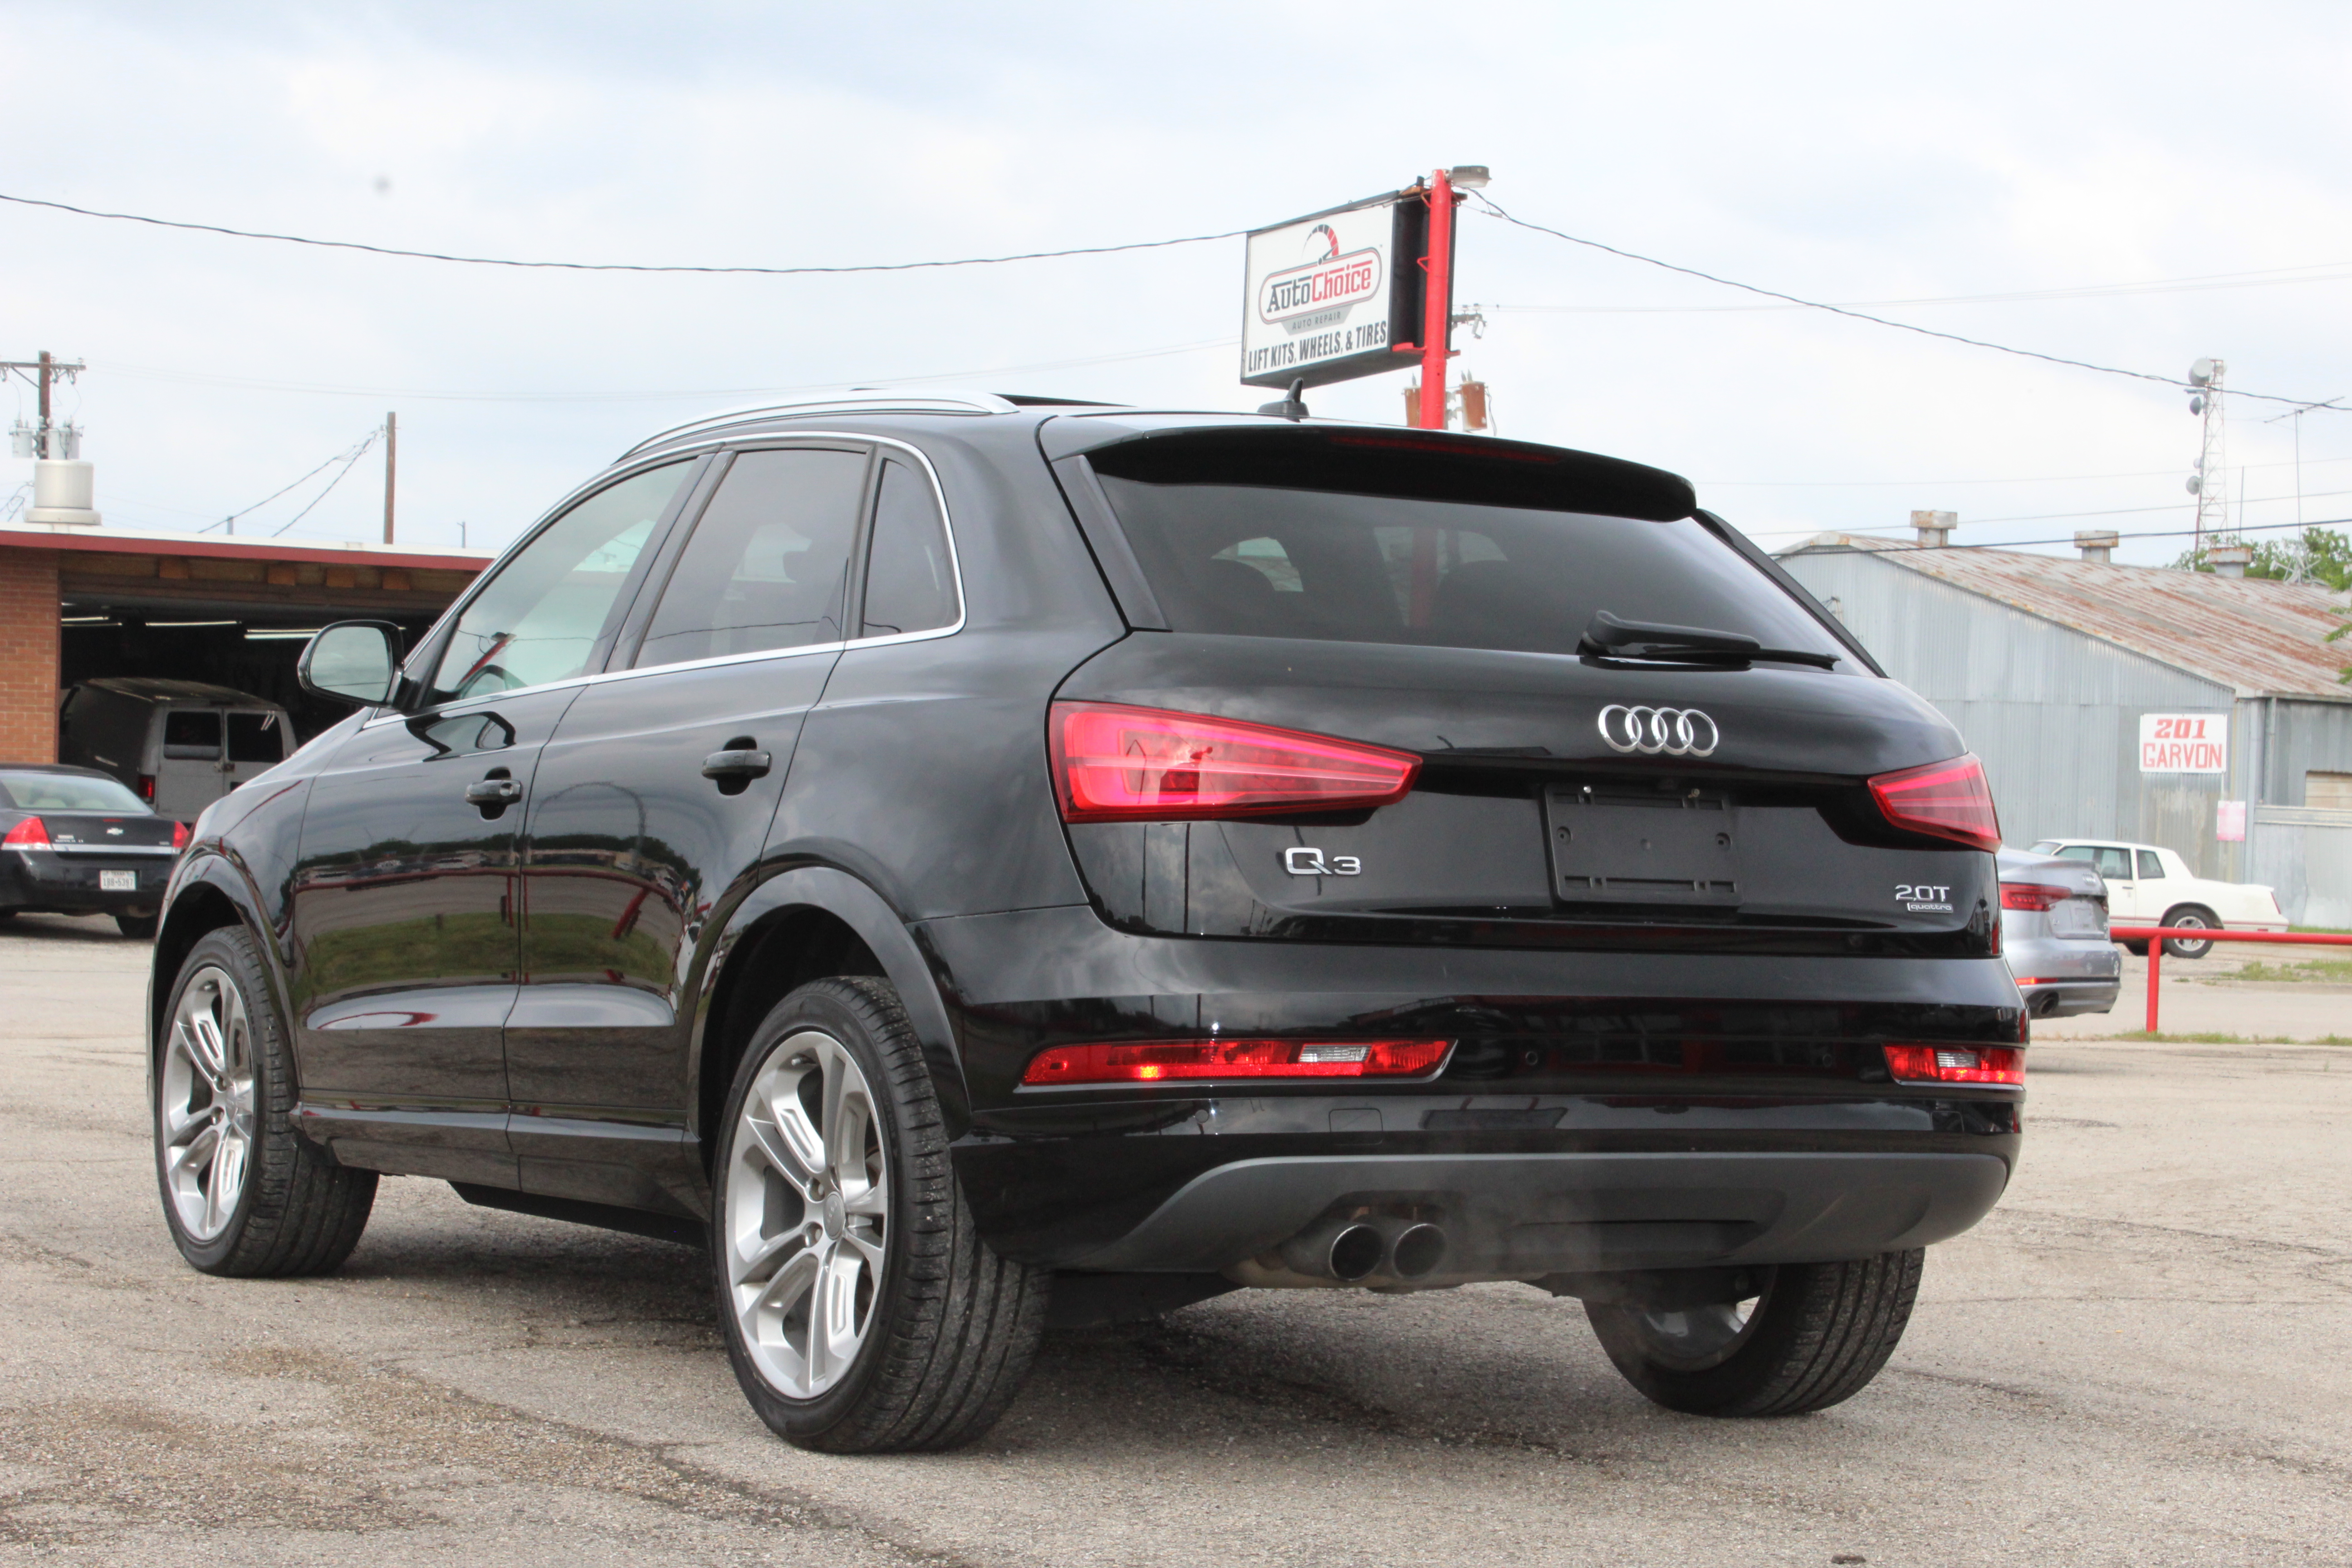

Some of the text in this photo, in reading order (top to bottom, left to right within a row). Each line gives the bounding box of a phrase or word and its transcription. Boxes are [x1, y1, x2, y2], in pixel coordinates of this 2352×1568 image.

[1266, 260, 1373, 313] AutoChoice
[1292, 311, 1341, 330] AUTO REPAIR
[1249, 320, 1387, 372] LIFT KITS, WHEELS, & TIRES
[2154, 718, 2206, 739] 201
[2142, 742, 2222, 769] GARVON
[1285, 847, 1361, 875] Q3
